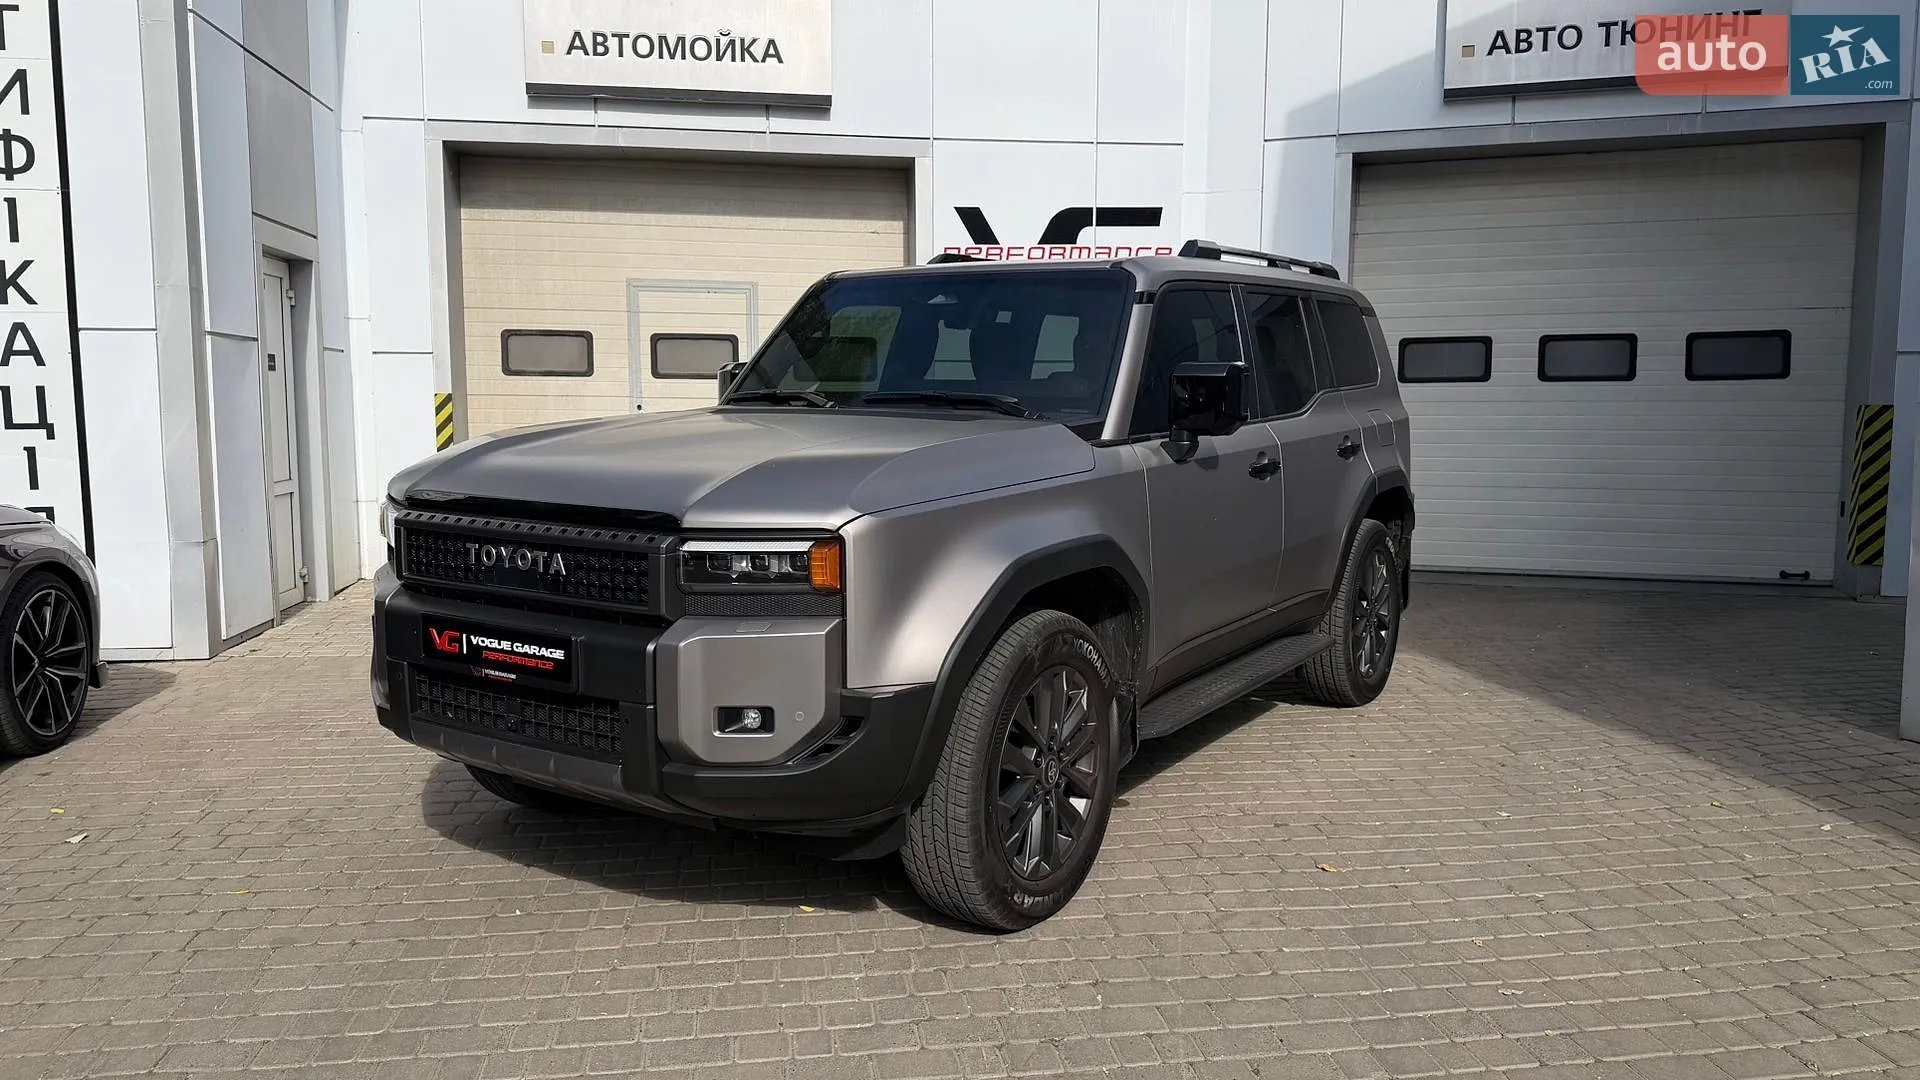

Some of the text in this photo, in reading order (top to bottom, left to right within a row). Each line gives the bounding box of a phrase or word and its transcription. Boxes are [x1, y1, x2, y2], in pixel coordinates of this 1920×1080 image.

[566, 29, 784, 64] АВТОМОЙКА
[1487, 8, 1763, 57] АВТО ТЮНИНГ
[0, 4, 56, 523] ТИФІКАЦІ
[466, 543, 566, 575] TOYOTA
[430, 628, 565, 660] VG VOGUE GARAGE
